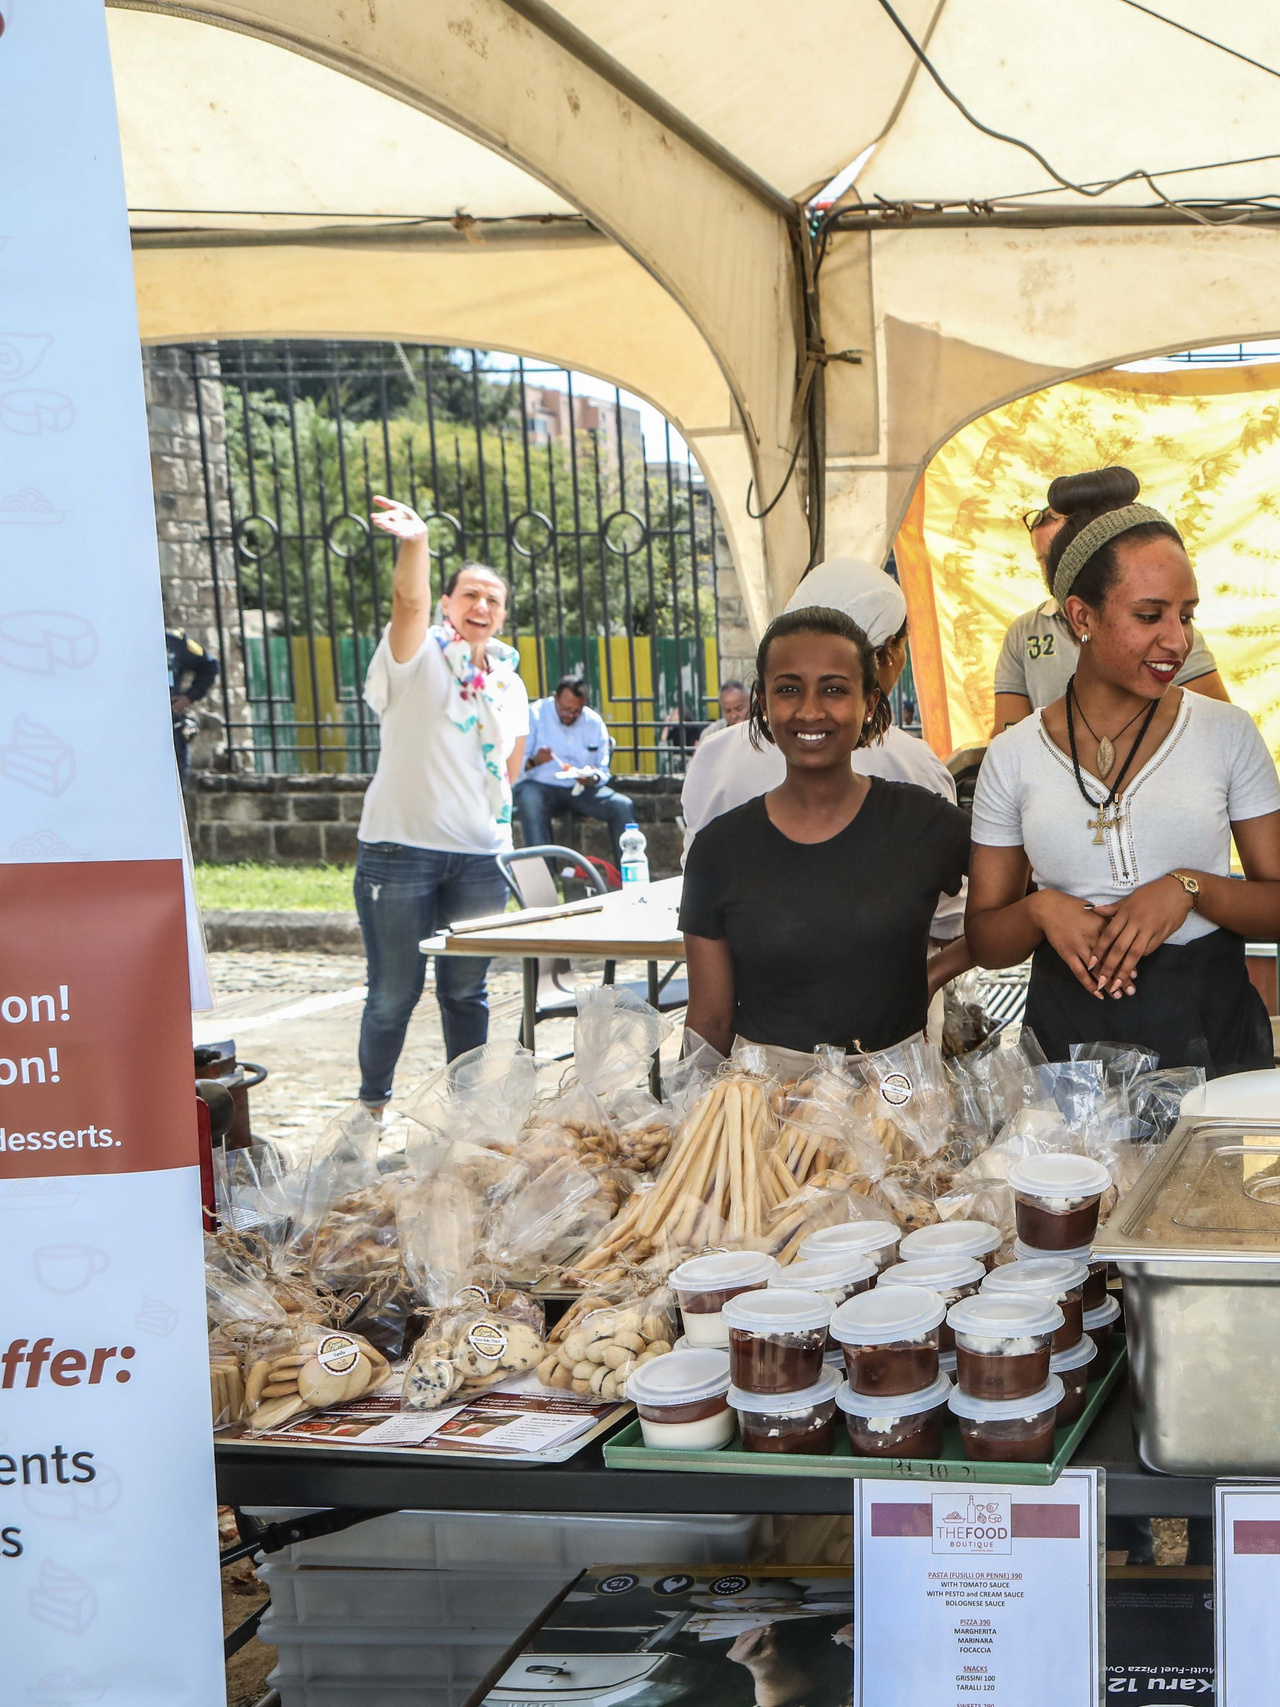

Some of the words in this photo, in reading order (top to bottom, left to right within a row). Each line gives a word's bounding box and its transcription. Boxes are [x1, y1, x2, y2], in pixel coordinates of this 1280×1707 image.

[1027, 633, 1056, 659] 32
[1, 985, 71, 1023] on!
[1108, 1678, 1138, 1692] 12
[1148, 1678, 1216, 1692] Karu
